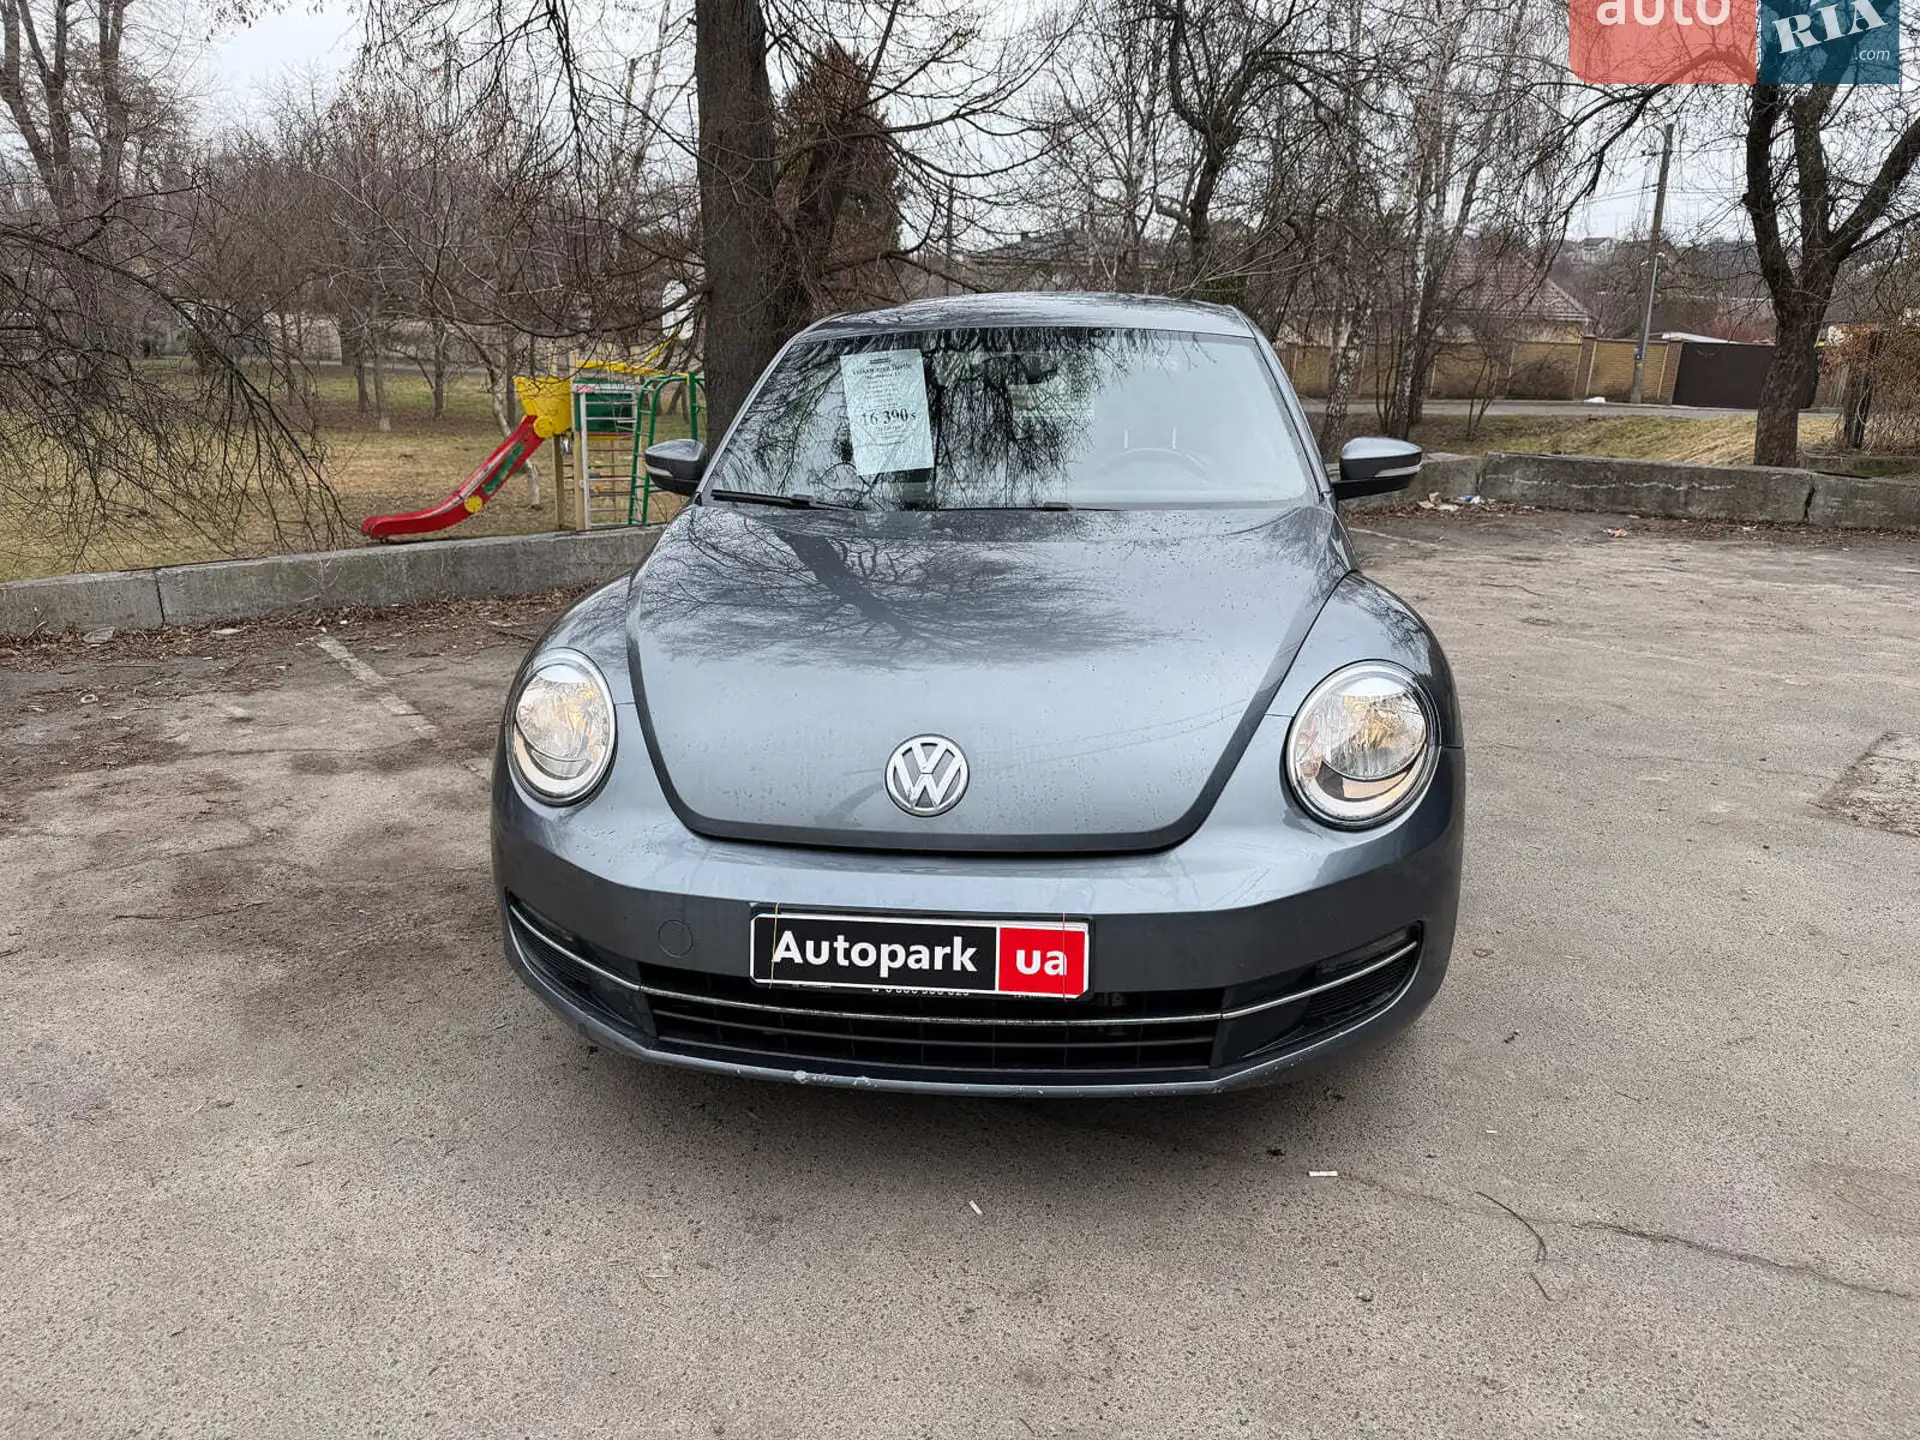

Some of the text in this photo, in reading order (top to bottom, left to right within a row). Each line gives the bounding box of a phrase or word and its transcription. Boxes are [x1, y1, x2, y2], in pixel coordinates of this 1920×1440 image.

[862, 411, 878, 425] 16
[886, 735, 969, 816] VW
[773, 930, 1068, 978] Autopark ua
